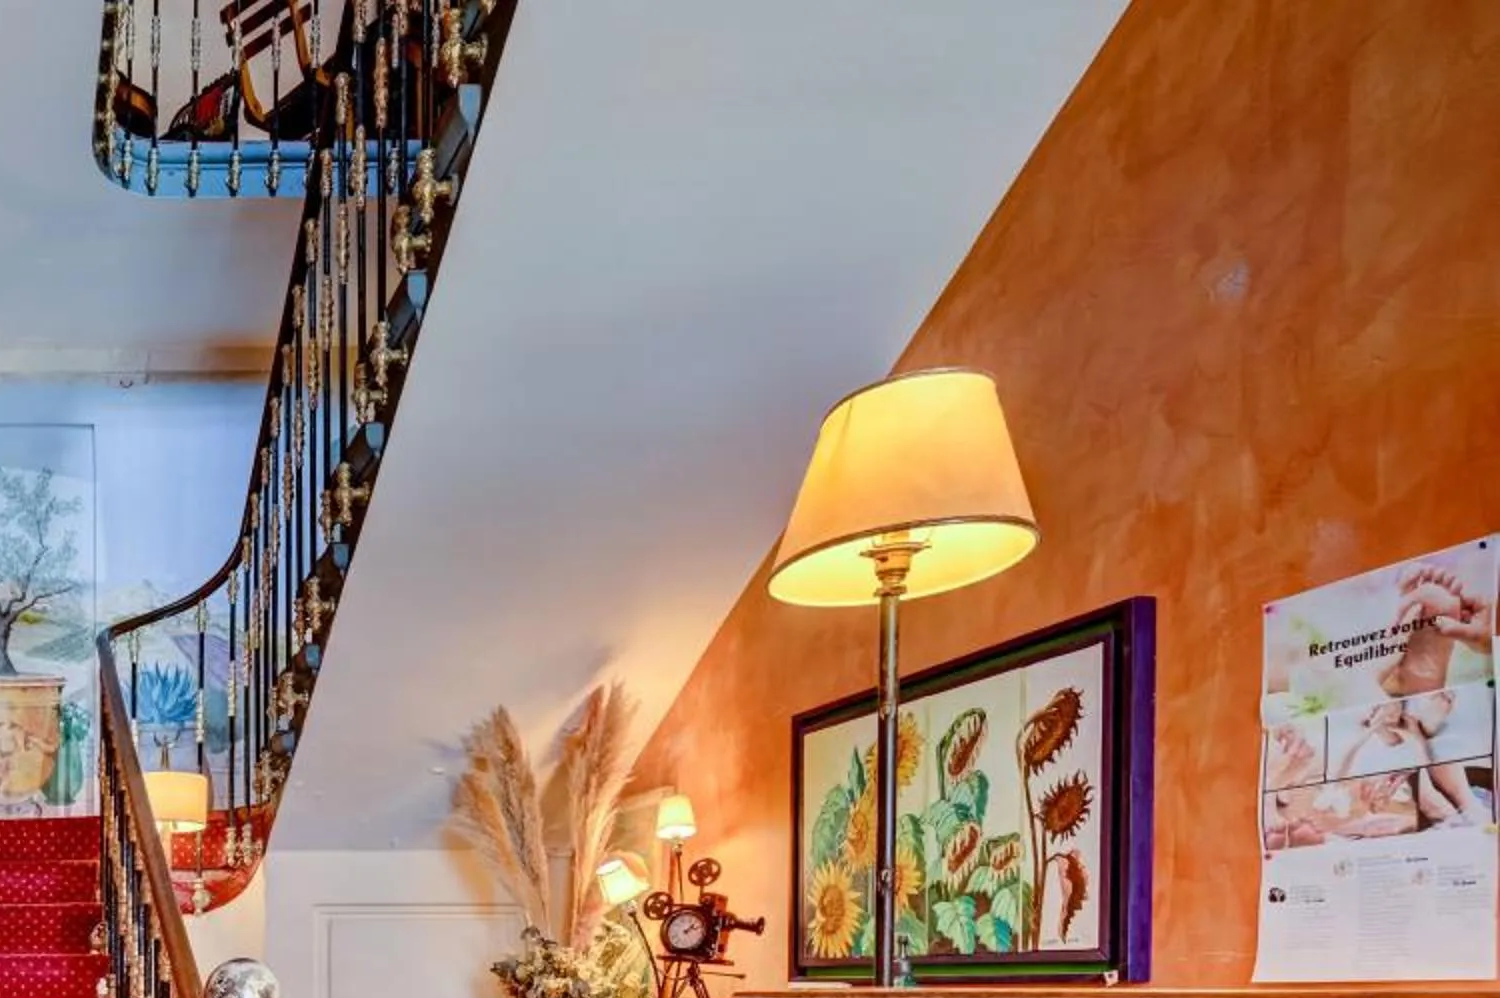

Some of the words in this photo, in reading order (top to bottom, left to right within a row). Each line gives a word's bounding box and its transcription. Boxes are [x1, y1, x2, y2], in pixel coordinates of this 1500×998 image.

[1308, 627, 1387, 658] Retrouvez
[1390, 615, 1438, 638] votre
[1334, 641, 1409, 669] Equilibre
